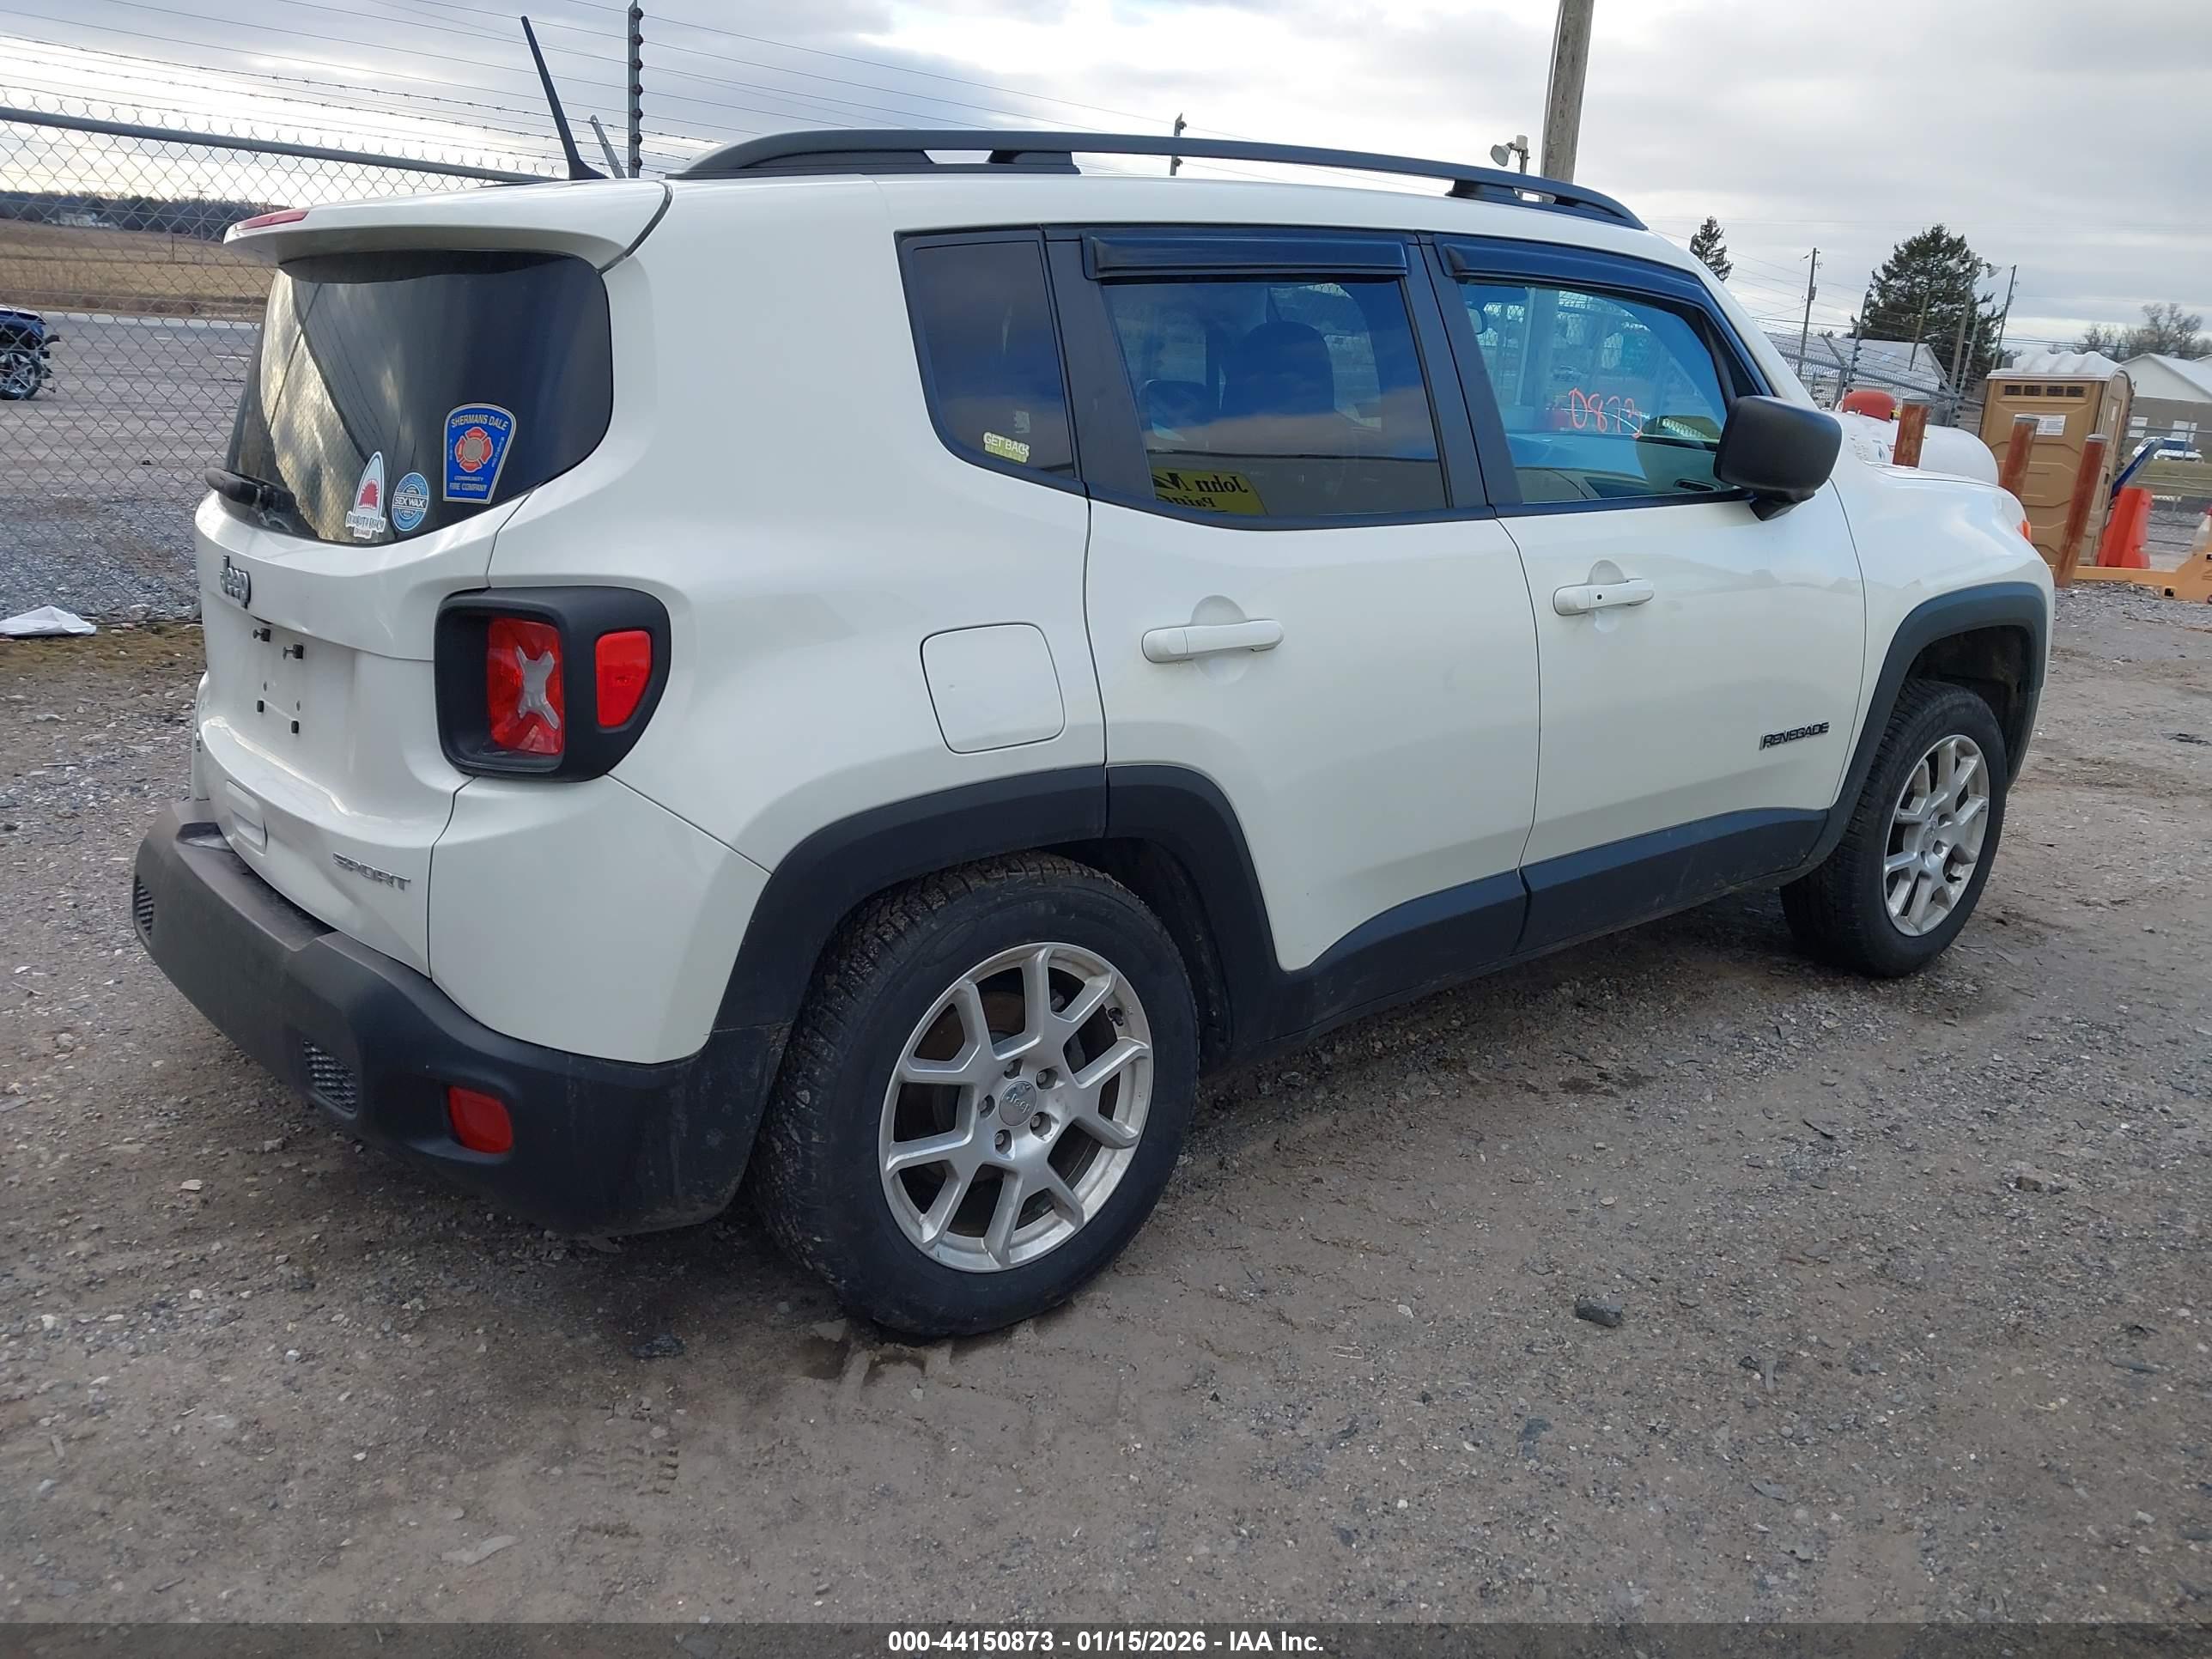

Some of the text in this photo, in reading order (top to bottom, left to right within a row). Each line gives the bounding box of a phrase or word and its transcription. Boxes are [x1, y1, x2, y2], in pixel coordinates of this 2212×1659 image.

[451, 414, 508, 431] SHERMANS DALE
[1568, 387, 1643, 439] 0873
[983, 432, 1005, 447] GET
[1005, 439, 1030, 456] BACK
[394, 496, 425, 508] SEX WAX
[220, 555, 252, 610] Jeep
[1759, 721, 1830, 750] RENEGADE
[332, 851, 411, 891] SPORT
[1006, 1093, 1031, 1114] Jeep
